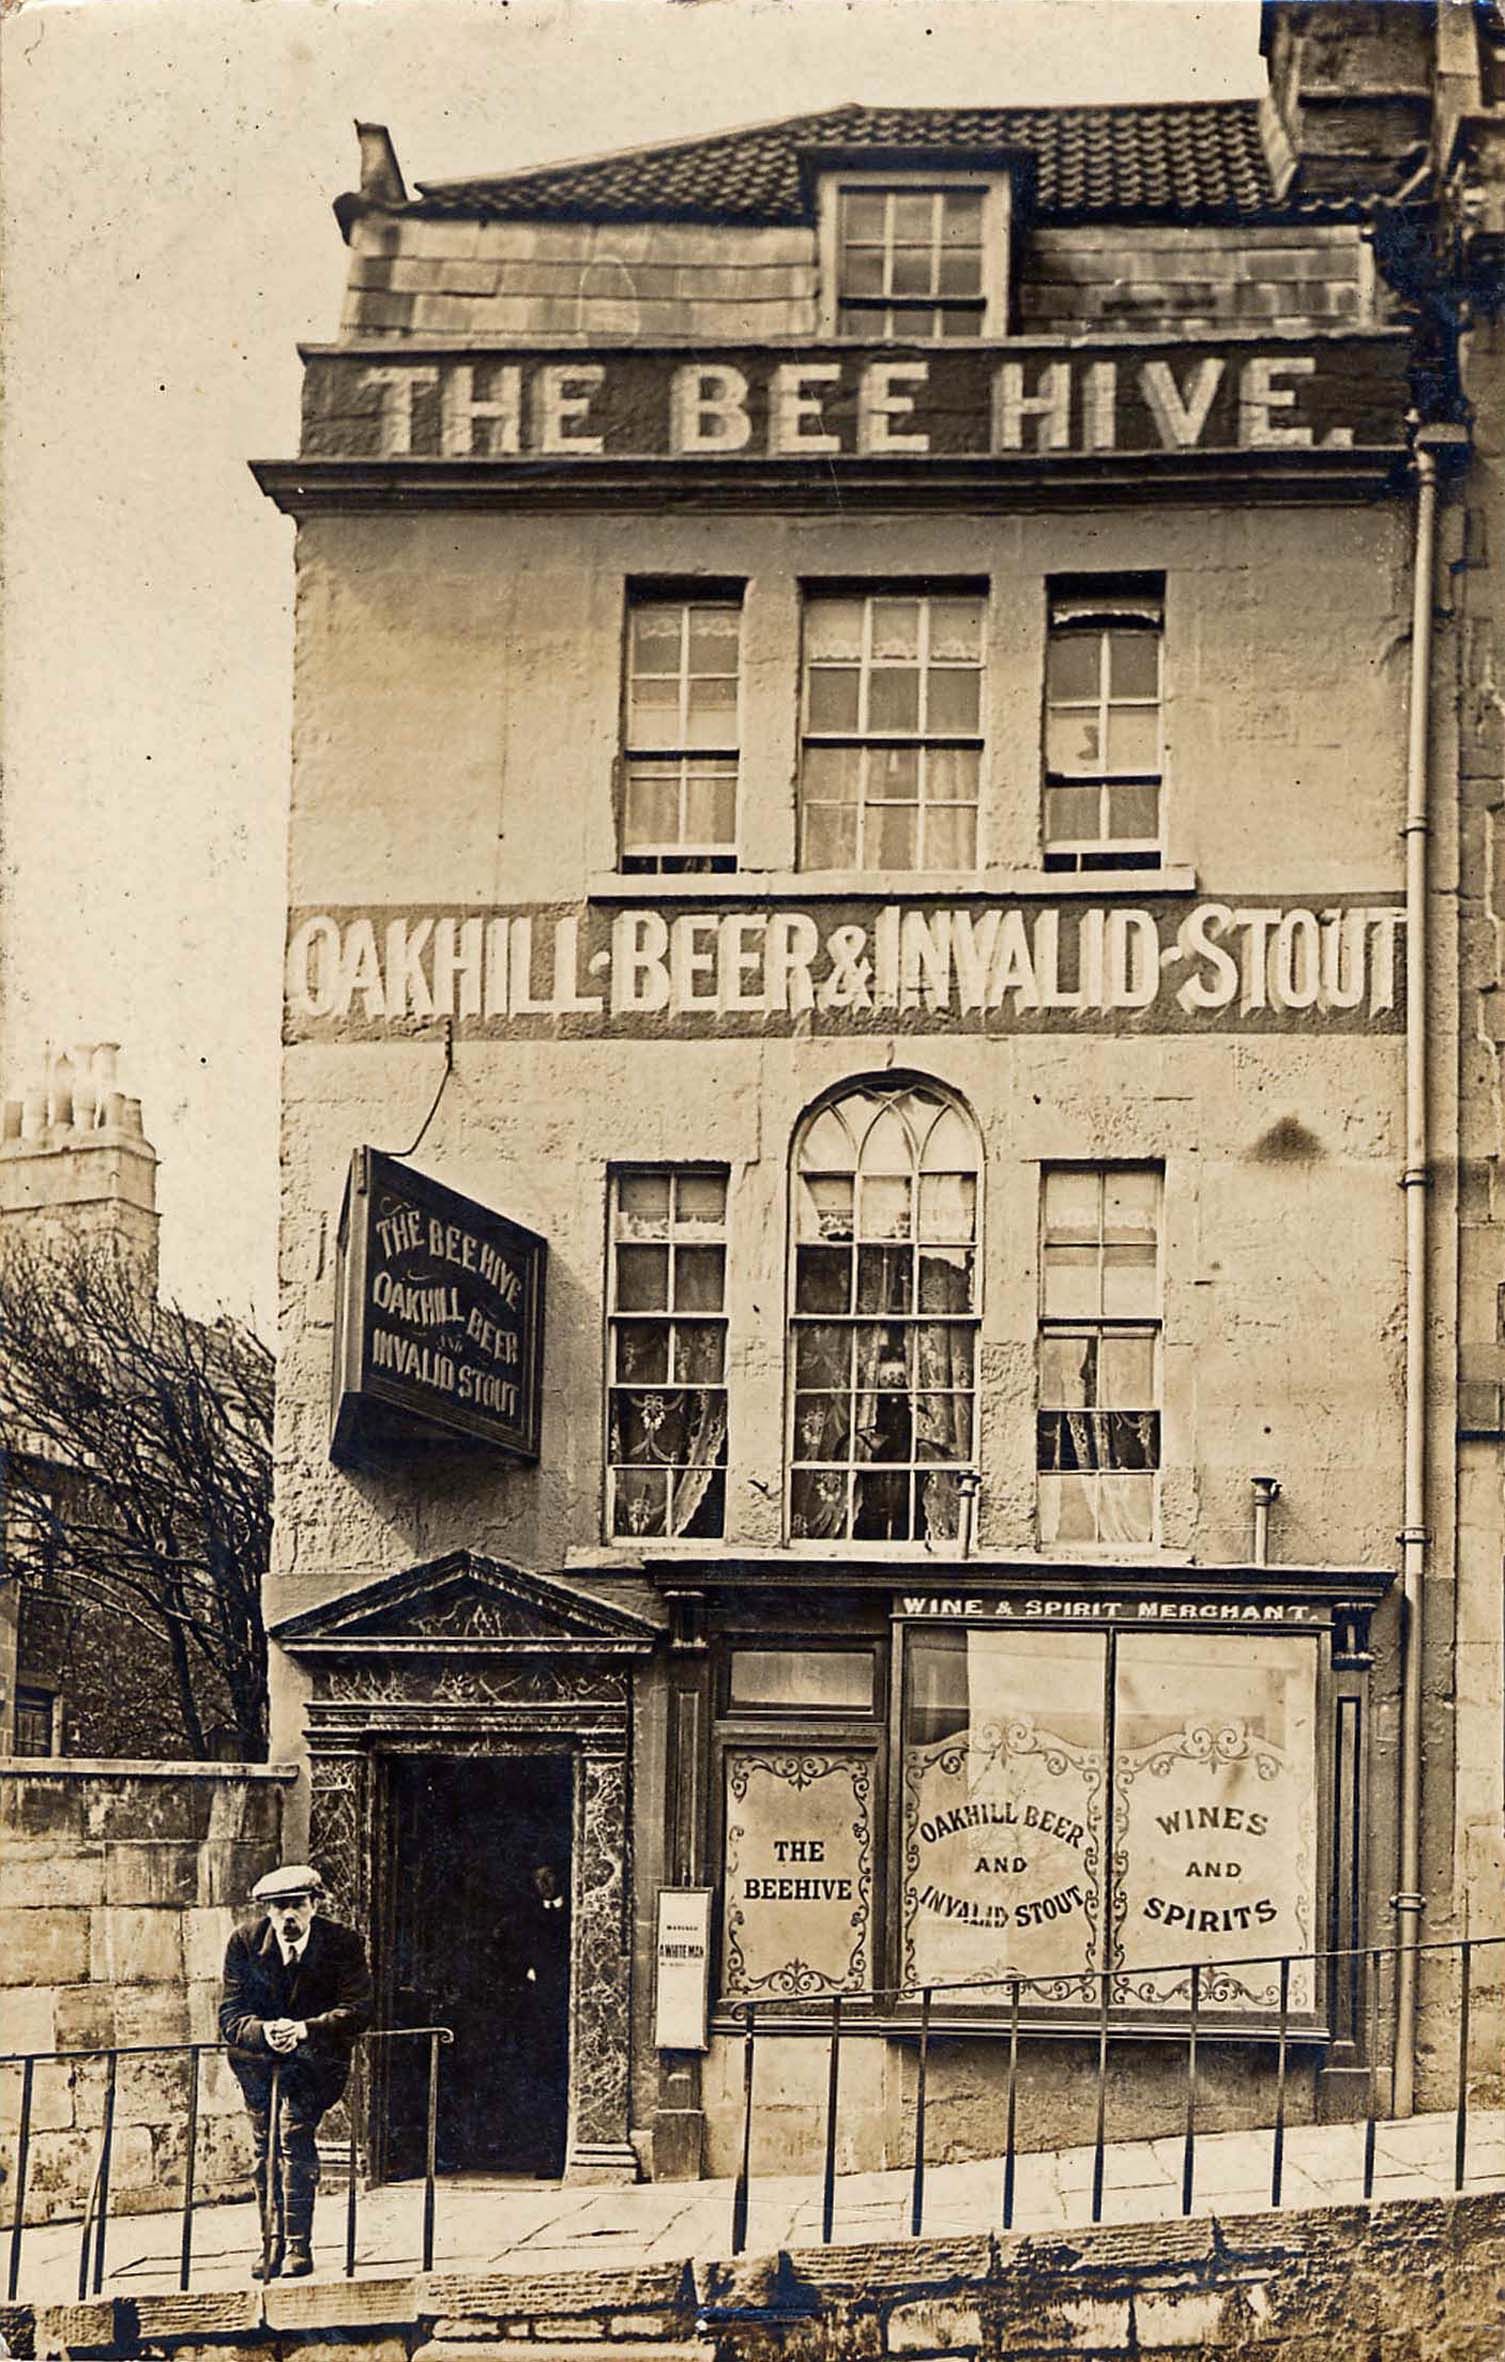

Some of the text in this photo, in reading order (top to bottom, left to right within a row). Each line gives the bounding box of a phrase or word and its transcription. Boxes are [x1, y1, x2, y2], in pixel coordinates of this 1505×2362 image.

[357, 364, 606, 459] THE
[668, 360, 932, 457] BEE
[286, 903, 1408, 1020] OAKHILL BEER & INVALID STOUT
[376, 1211, 424, 1258] THE
[373, 1271, 518, 1363] OAKHILL BEER
[373, 1329, 520, 1416] INVALID STOUT
[902, 1597, 984, 1616] WINE
[996, 1600, 1013, 1616] &
[1023, 1600, 1122, 1618] SPIRIT
[919, 1801, 1086, 1850] OAKHILL BEER
[1155, 1807, 1271, 1837] WINES
[773, 1840, 825, 1863] THE
[973, 1855, 1029, 1874] AND
[1185, 1861, 1244, 1879] AND
[743, 1878, 853, 1901] BEEHIVE
[919, 1884, 1085, 1930] INVALID STOUT
[1142, 1896, 1279, 1933] SPIRITS
